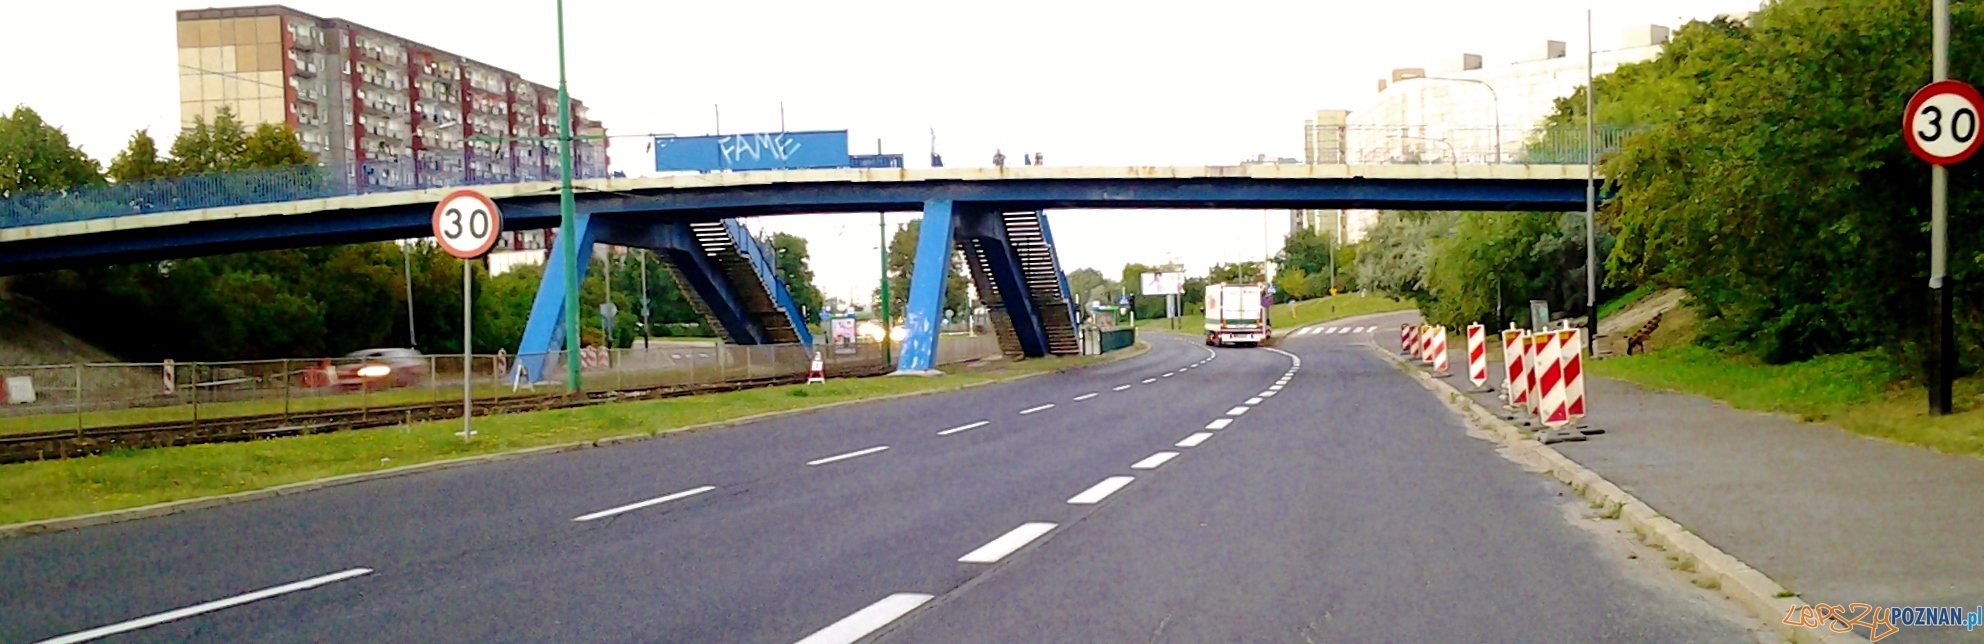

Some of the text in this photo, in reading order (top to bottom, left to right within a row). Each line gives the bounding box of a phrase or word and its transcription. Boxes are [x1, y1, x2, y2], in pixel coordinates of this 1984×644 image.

[1918, 105, 1976, 143] 30
[718, 132, 801, 163] FAME
[444, 208, 488, 239] 30
